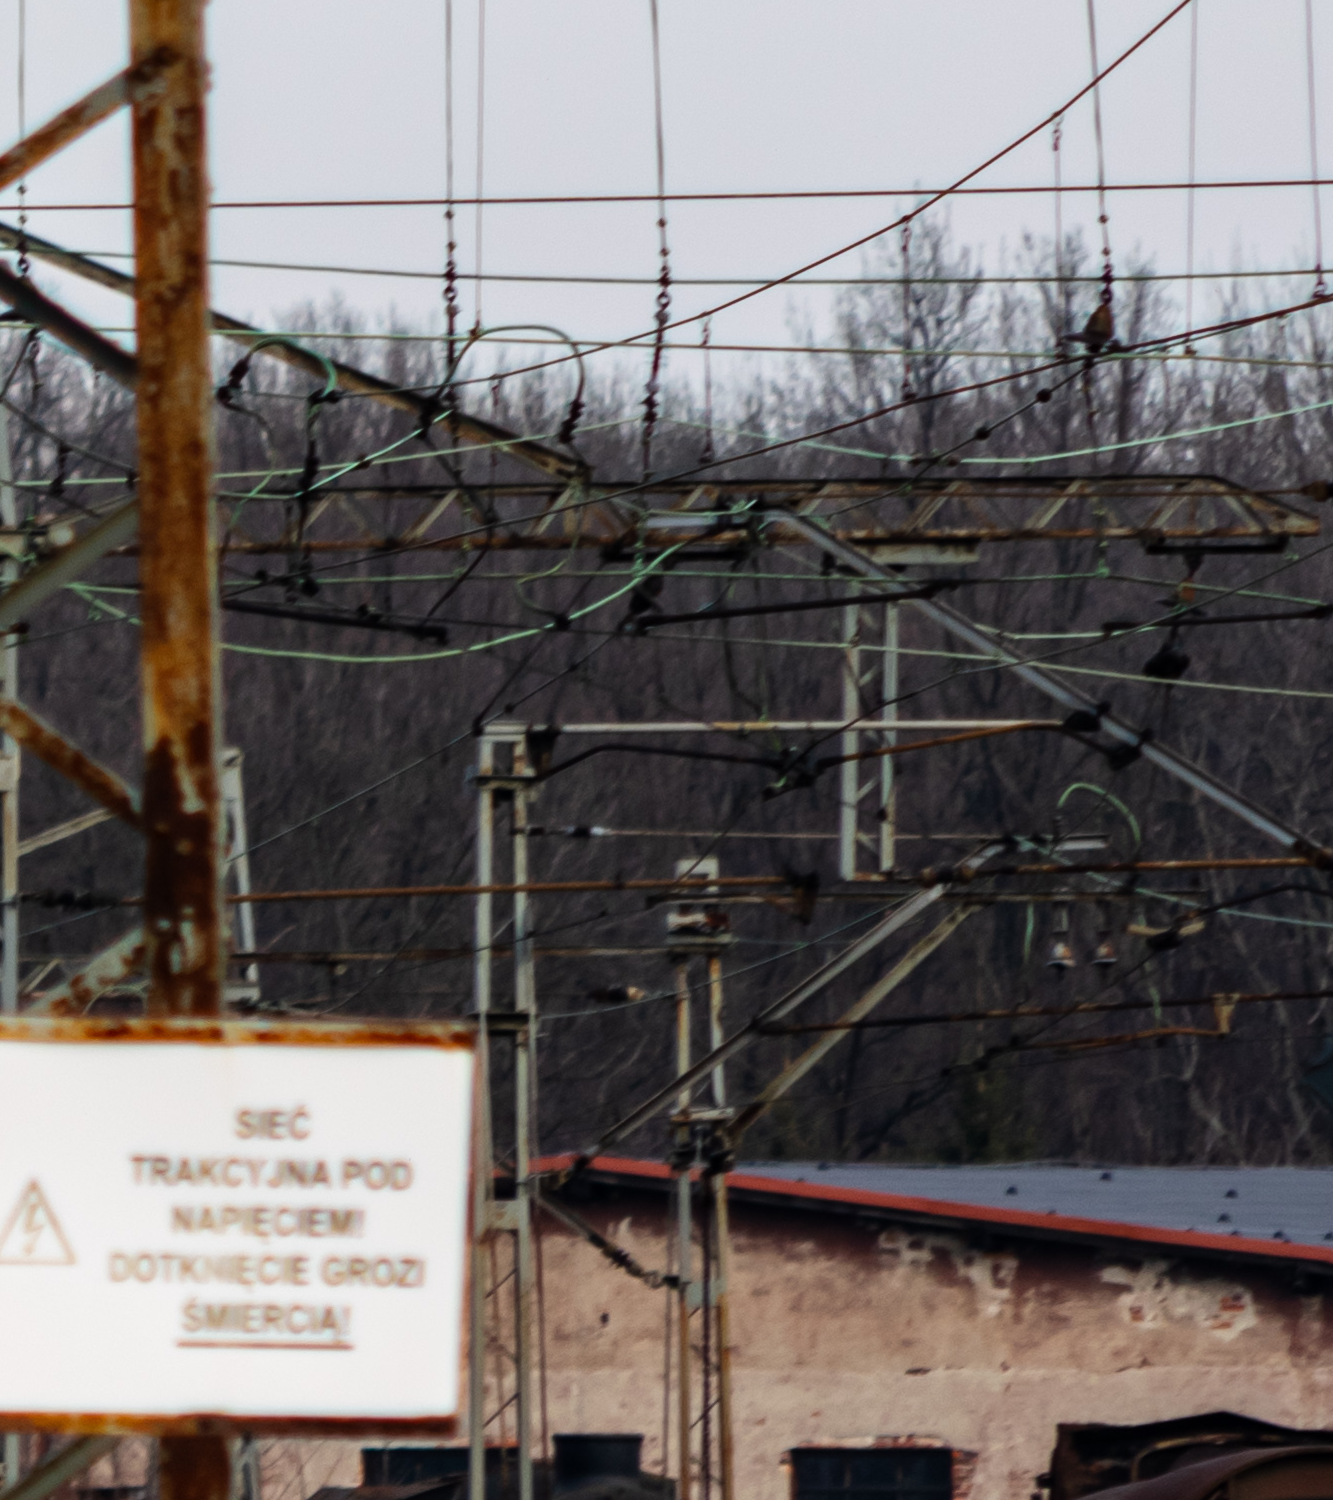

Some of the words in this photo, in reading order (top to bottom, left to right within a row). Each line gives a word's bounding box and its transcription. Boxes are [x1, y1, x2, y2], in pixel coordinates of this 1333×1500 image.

[235, 1104, 312, 1141] SIEĆ
[131, 1154, 333, 1188] TRAKCYJNA
[341, 1159, 413, 1191] POD
[171, 1206, 364, 1242] NAPIĘCIEM!
[108, 1253, 309, 1289] DOTKNIĘCIE
[322, 1257, 427, 1288] GROZI
[180, 1297, 352, 1339] ŚMIERCIĄ!
